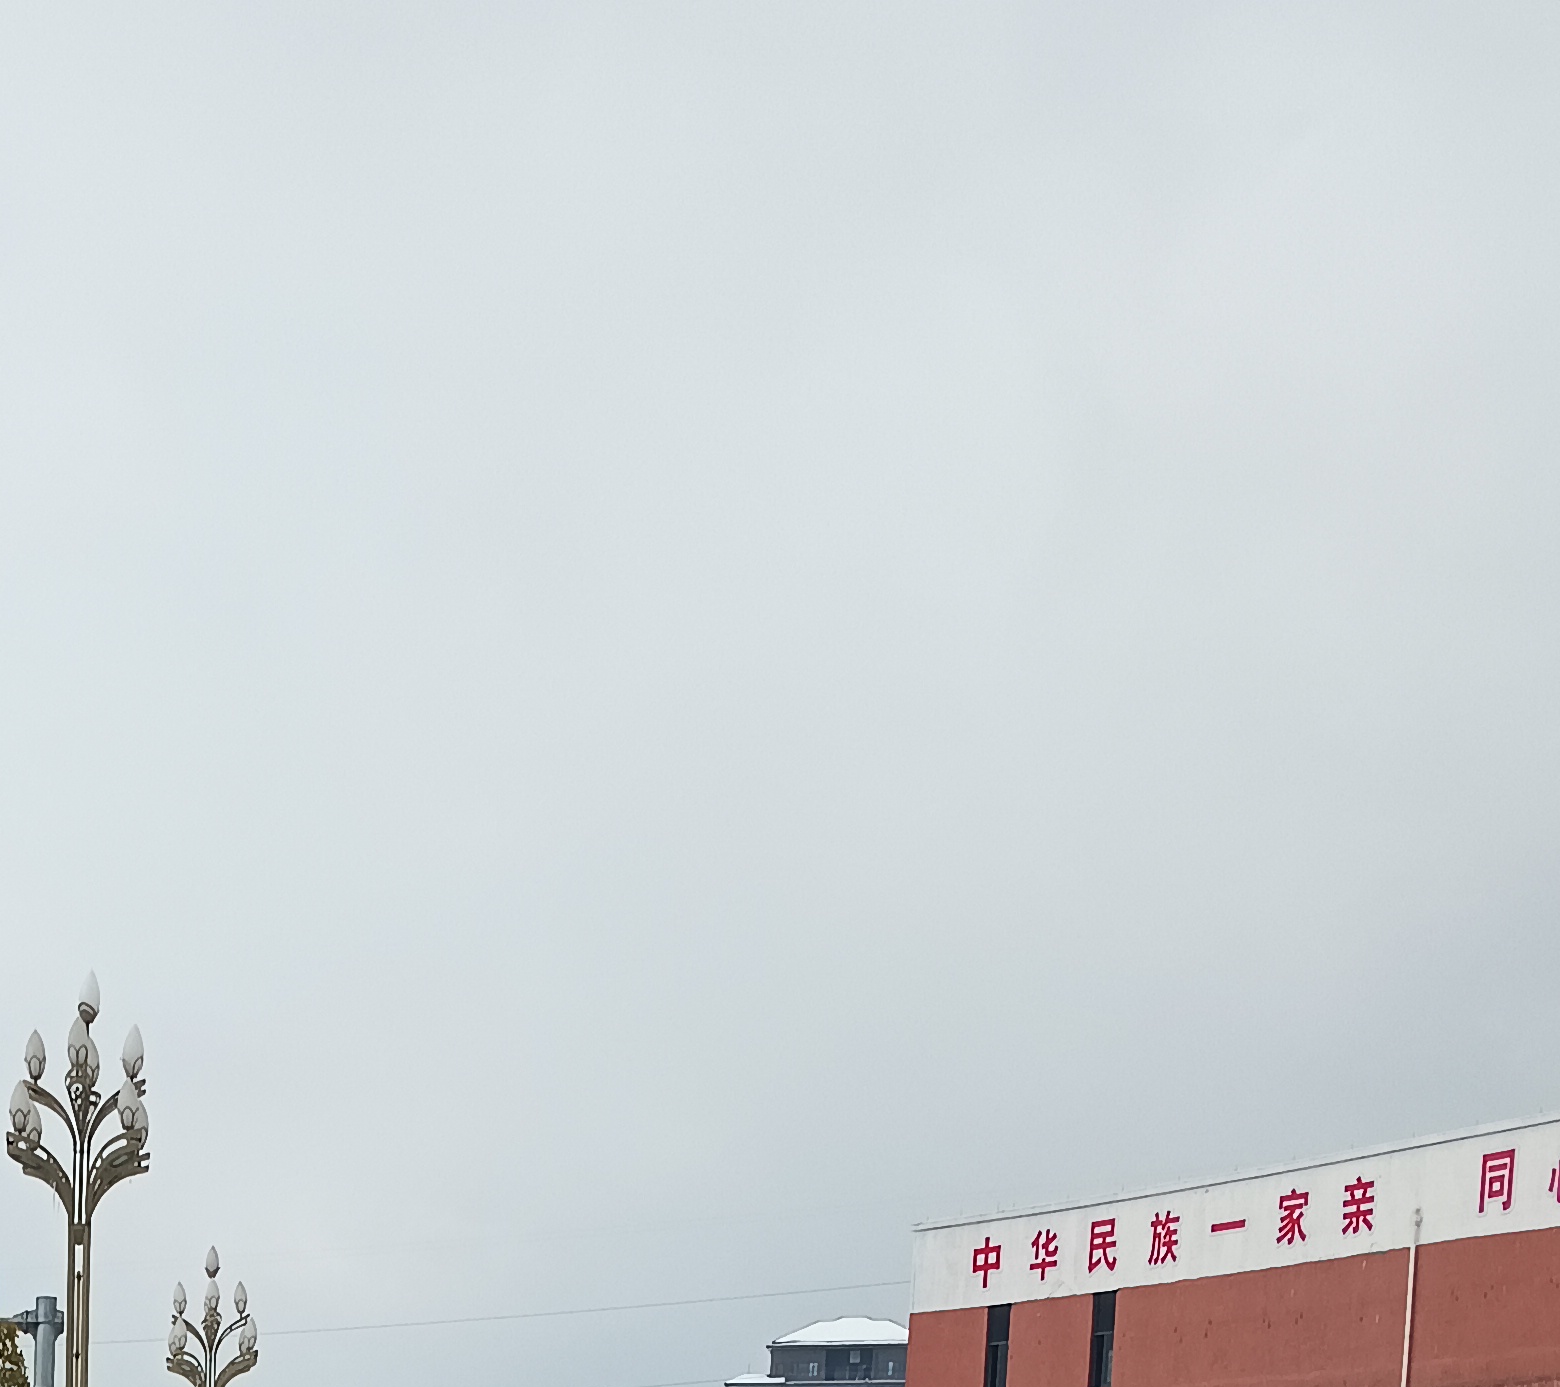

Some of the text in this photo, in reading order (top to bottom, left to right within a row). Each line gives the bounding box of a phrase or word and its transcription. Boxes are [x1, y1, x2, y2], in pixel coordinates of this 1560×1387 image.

[972, 1175, 1375, 1290] 中华民族一家亲
